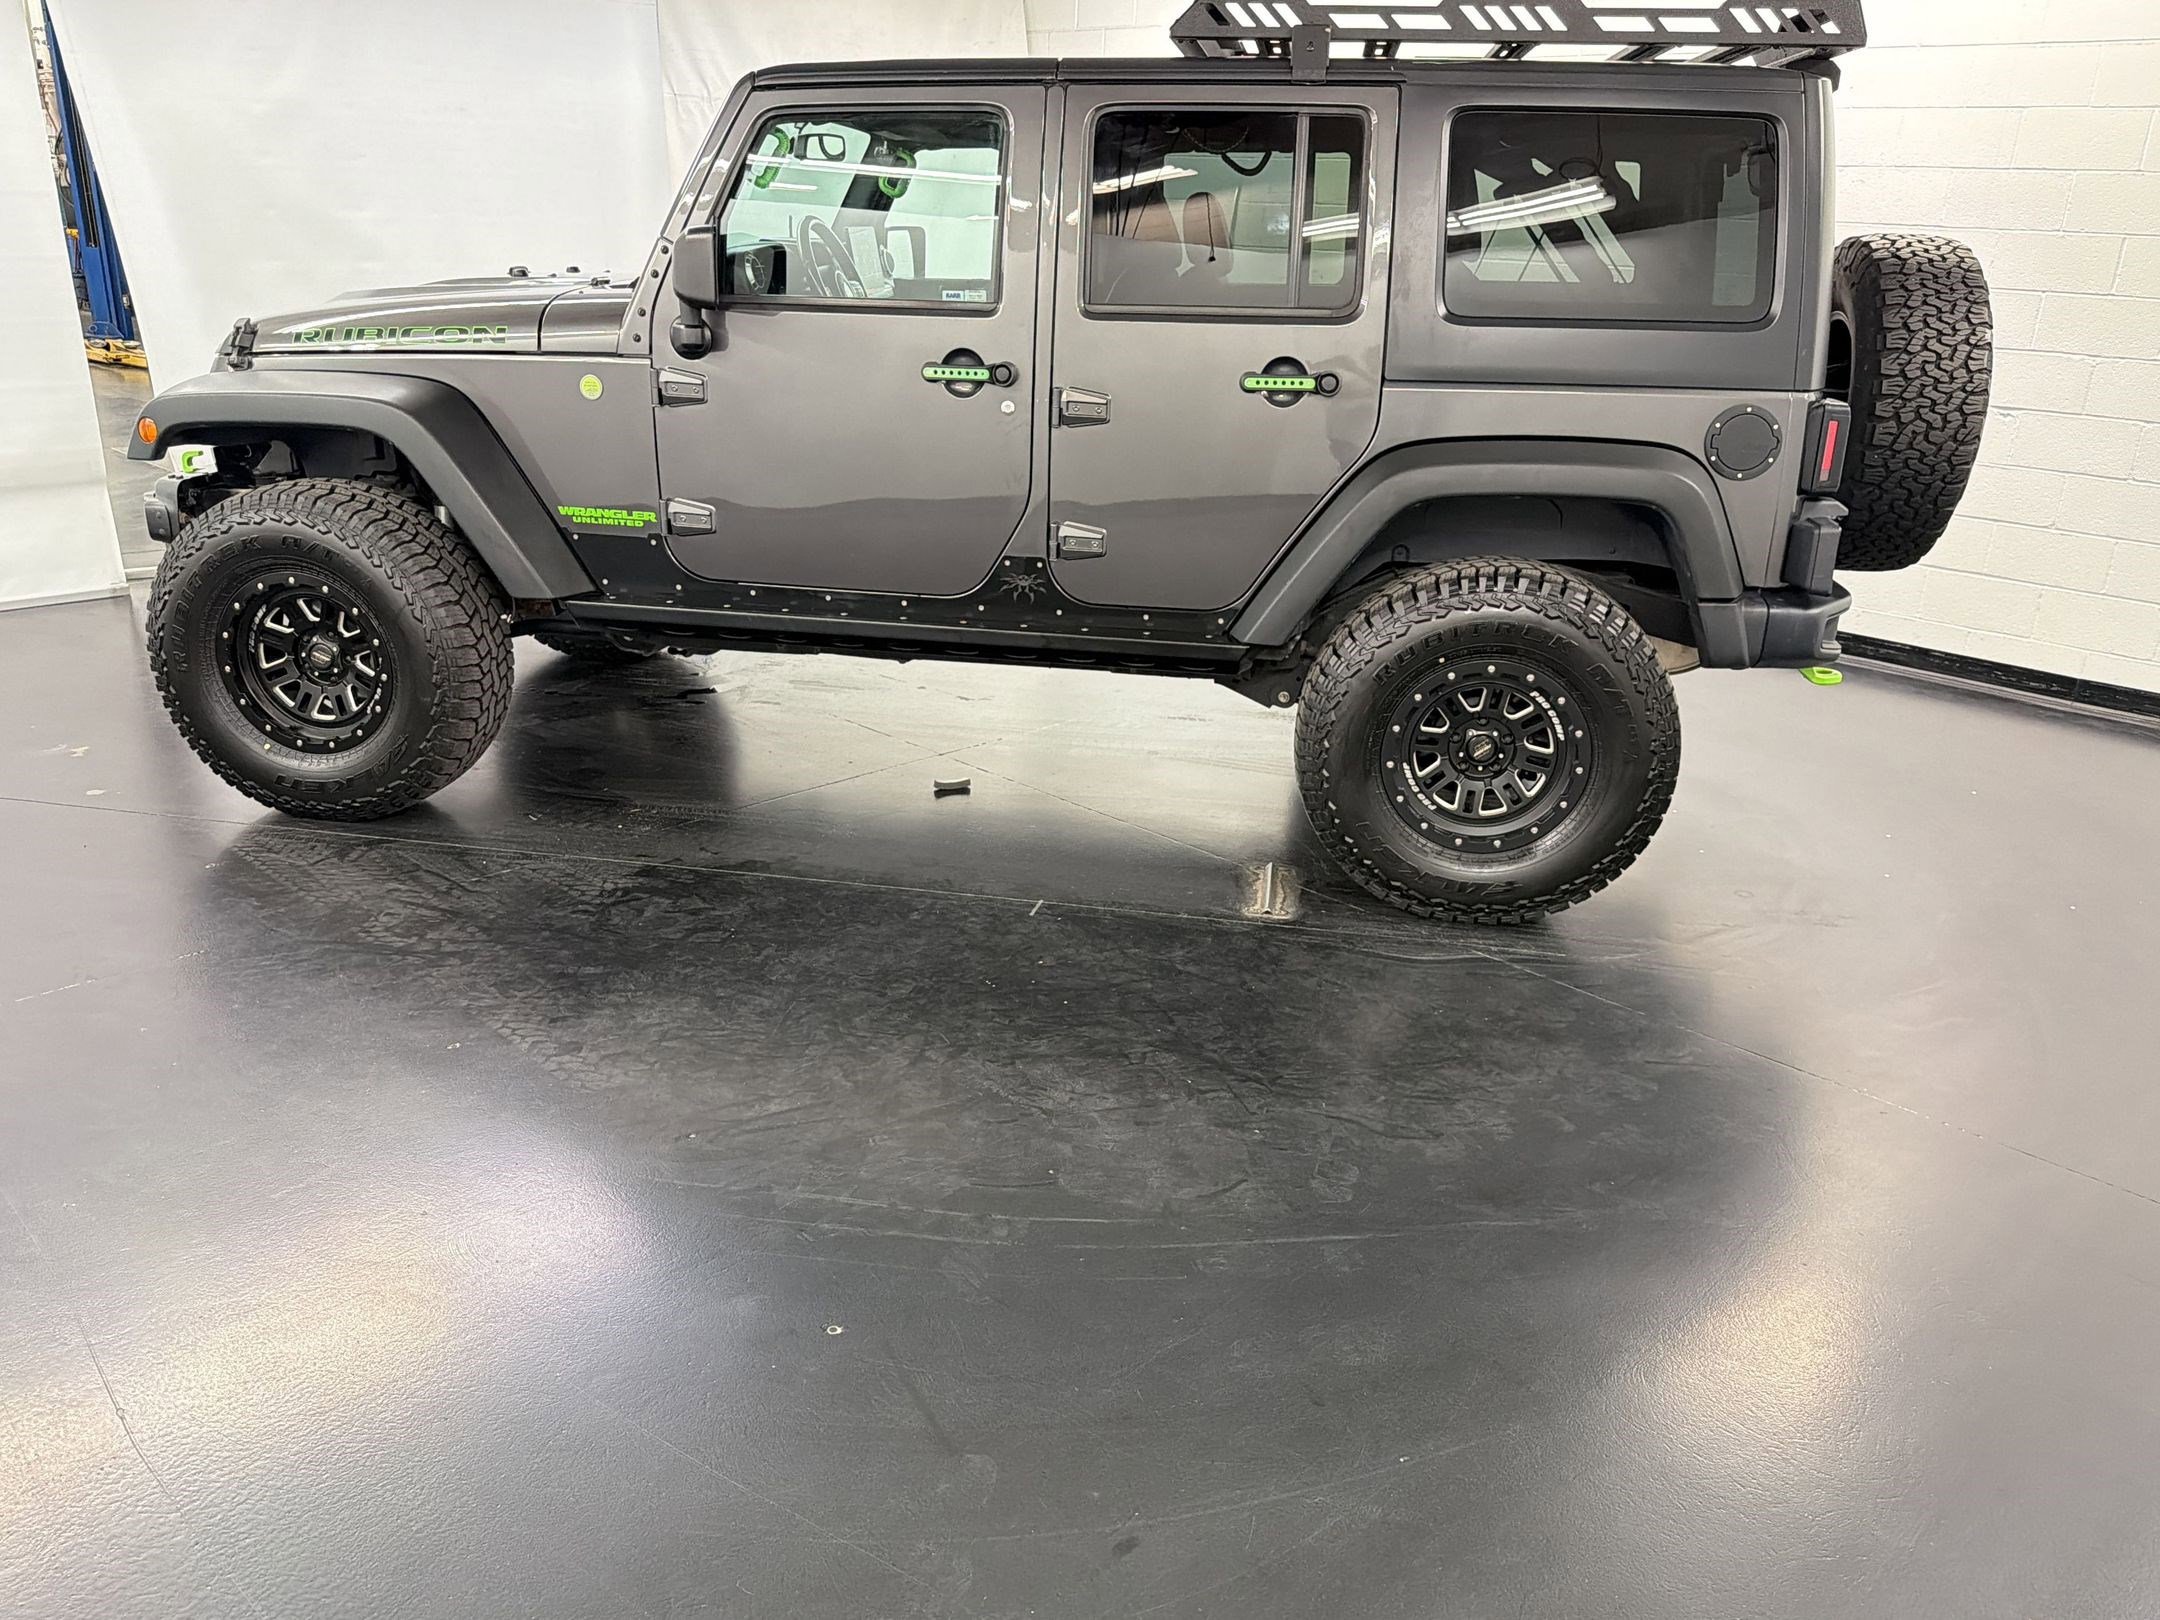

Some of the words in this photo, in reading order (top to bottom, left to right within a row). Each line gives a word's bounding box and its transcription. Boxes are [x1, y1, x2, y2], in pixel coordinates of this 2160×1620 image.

[291, 325, 509, 345] RUBICON
[557, 505, 658, 523] WRANGLER
[572, 516, 645, 527] UNLIMITED
[1529, 690, 1551, 709] PRO
[1547, 709, 1565, 741] COMP
